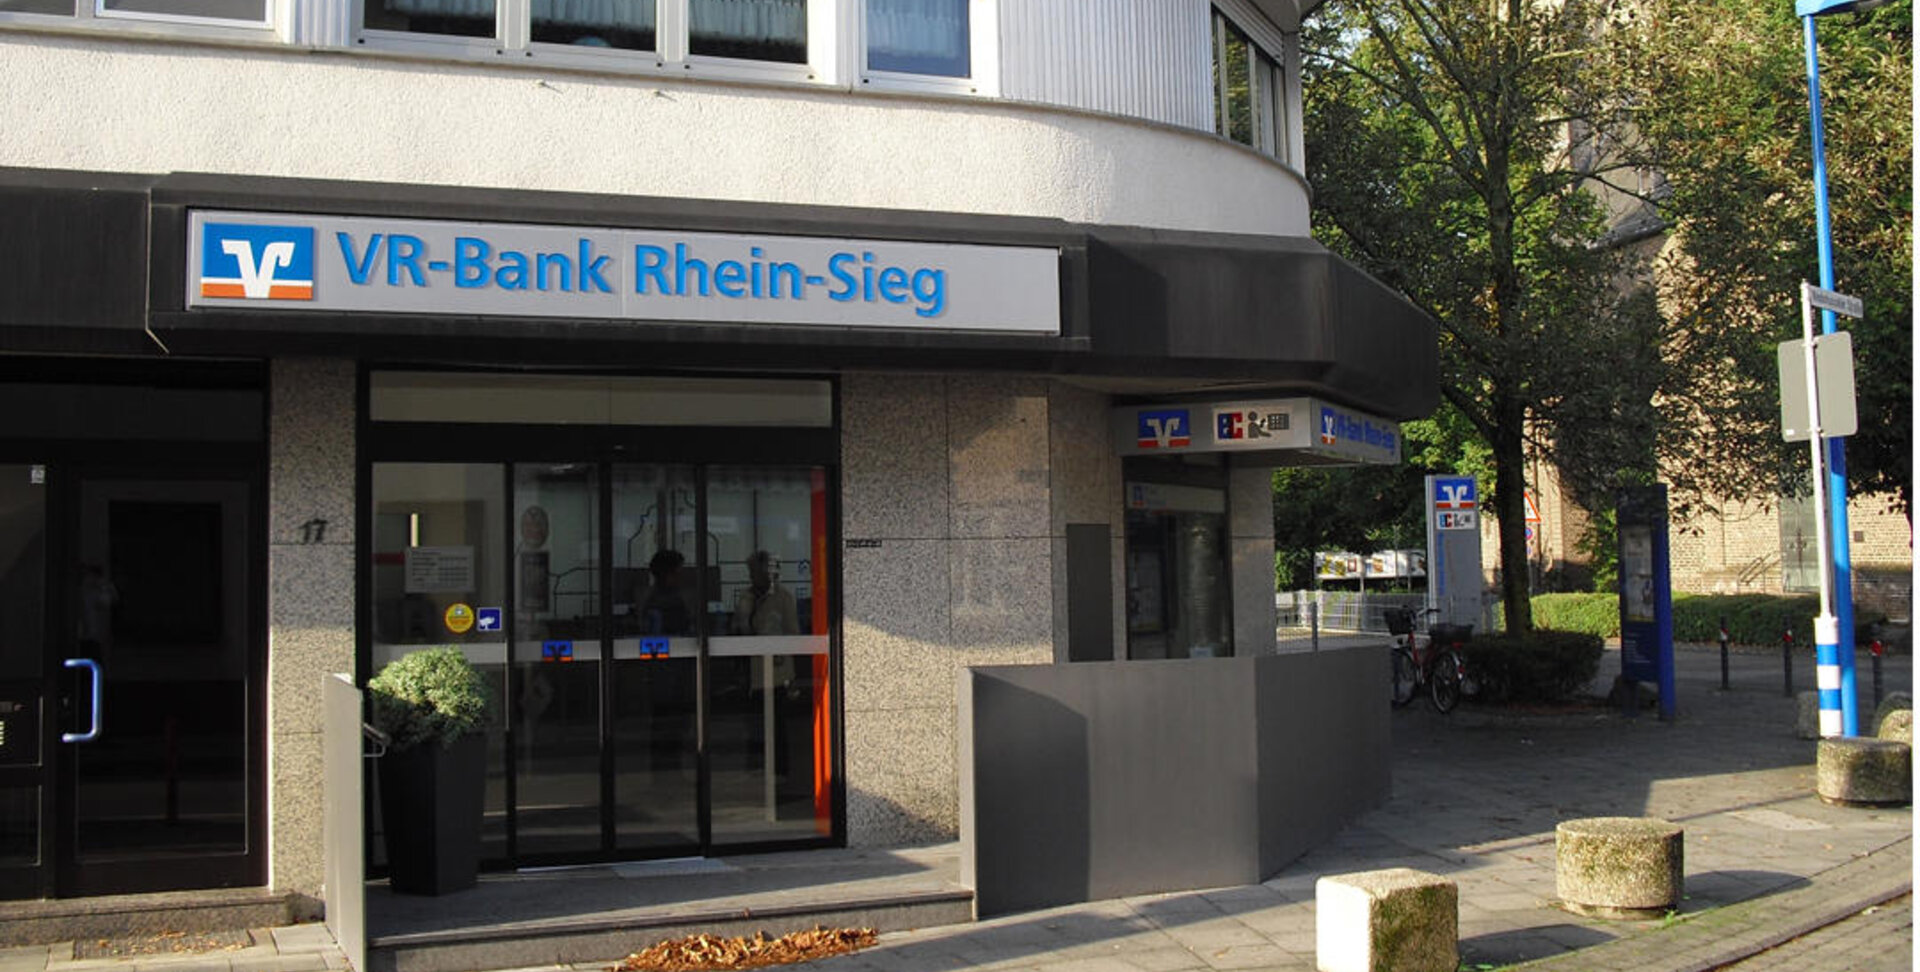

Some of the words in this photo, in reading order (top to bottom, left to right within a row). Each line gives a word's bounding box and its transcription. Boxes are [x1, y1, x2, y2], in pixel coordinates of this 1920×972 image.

[336, 231, 614, 294] VR-Bank
[634, 242, 947, 318] Rhein-Sieg
[300, 518, 328, 544] 17
